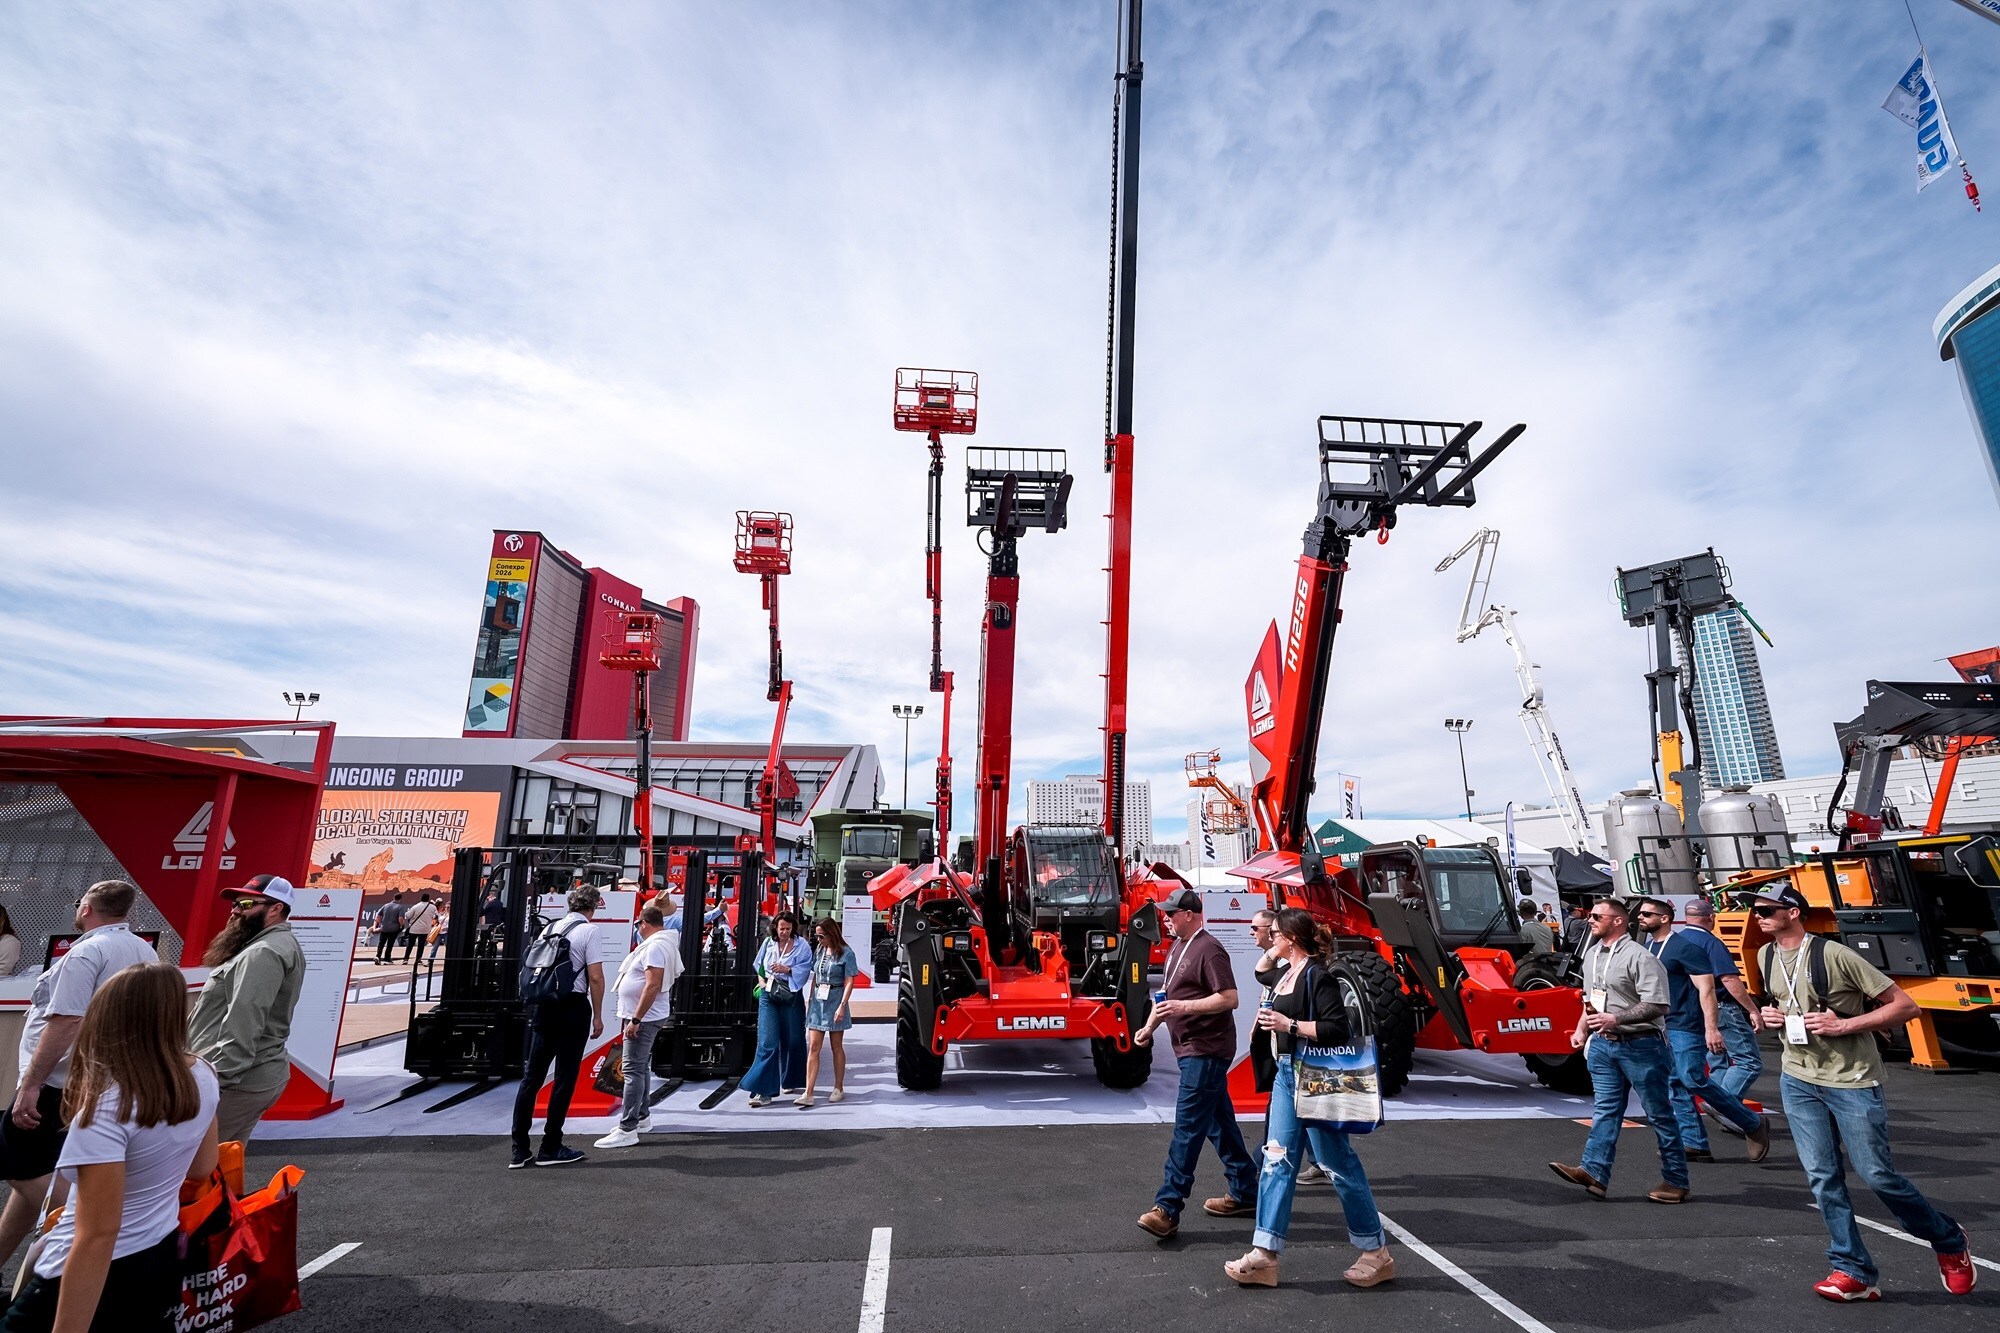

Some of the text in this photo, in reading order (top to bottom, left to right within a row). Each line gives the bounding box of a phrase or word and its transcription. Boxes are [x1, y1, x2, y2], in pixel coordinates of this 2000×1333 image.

[496, 563, 525, 571] Conexpo
[601, 593, 636, 612] CONRAD
[1288, 576, 1308, 672] H1256
[1251, 714, 1275, 738] LGMG
[325, 767, 464, 788] INGONG GROUP
[378, 809, 469, 827] STRENGTH
[315, 824, 464, 844] OCAL COMMITMENT
[161, 855, 237, 870] LGG
[997, 1016, 1066, 1030] LGMG
[1497, 1017, 1551, 1033] LGMG
[1308, 1046, 1356, 1057] HYUNDAI
[182, 1262, 228, 1291] HERE
[196, 1273, 247, 1308] HARD
[174, 1299, 234, 1333] WORK
